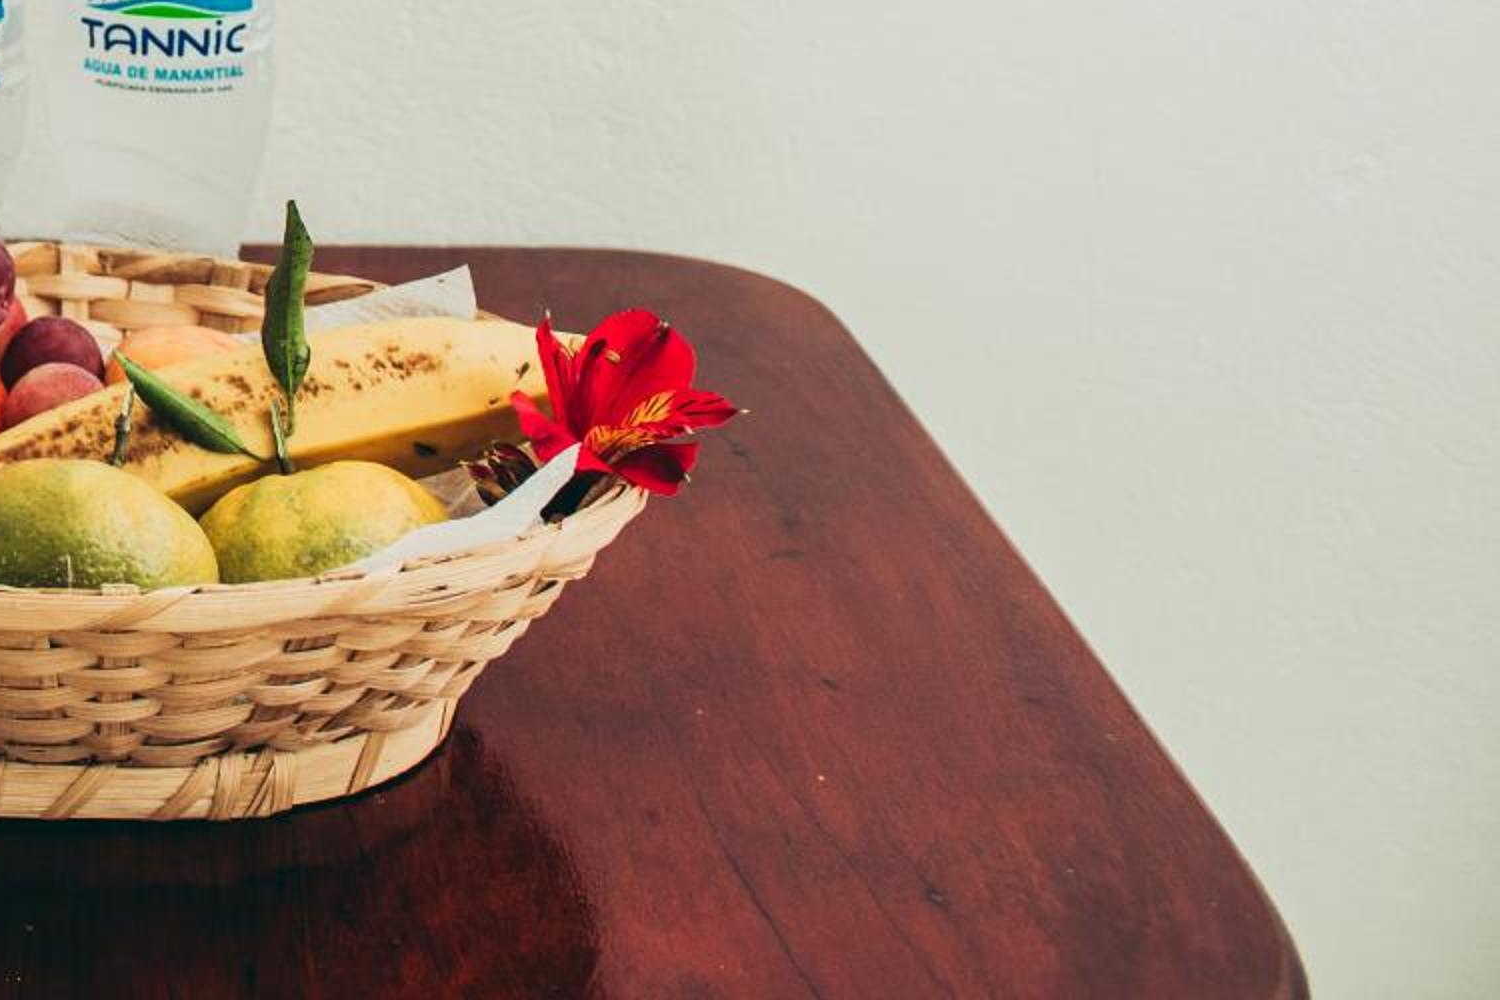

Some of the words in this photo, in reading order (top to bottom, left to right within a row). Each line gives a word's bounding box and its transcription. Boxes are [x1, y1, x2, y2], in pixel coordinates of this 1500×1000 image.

[84, 57, 122, 77] AGUA
[127, 65, 148, 79] DE
[154, 64, 244, 82] MANANTIAL
